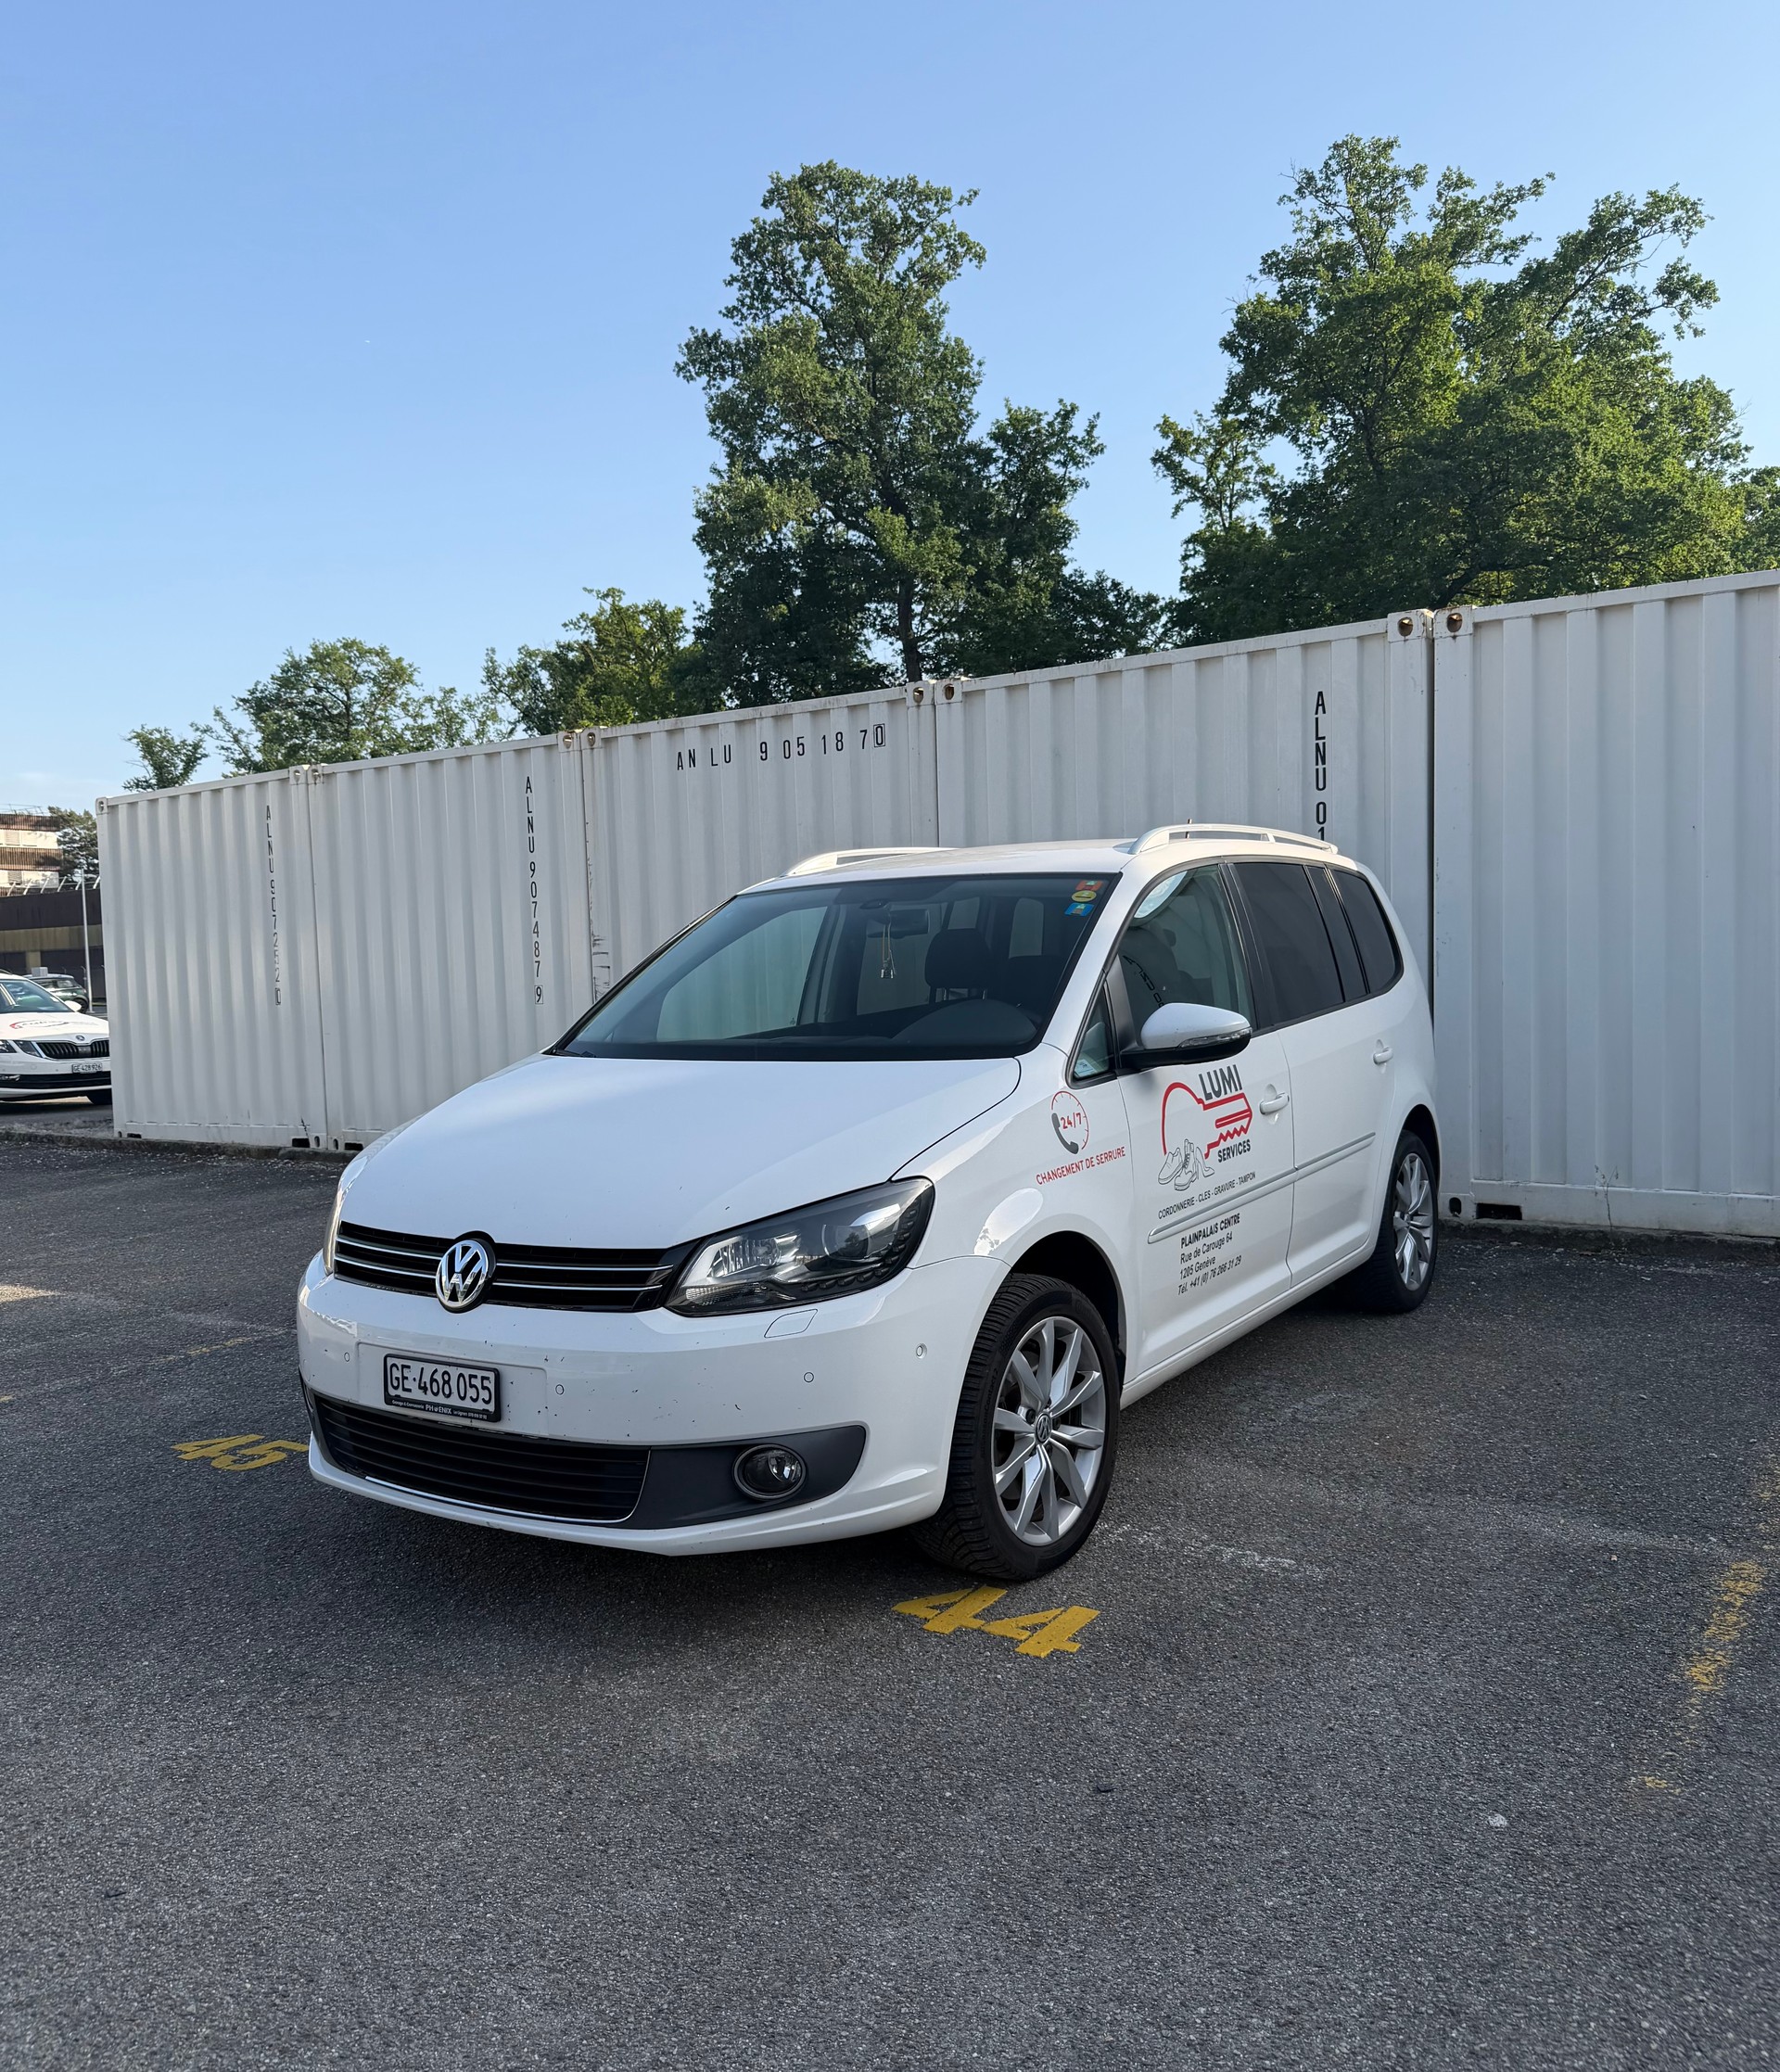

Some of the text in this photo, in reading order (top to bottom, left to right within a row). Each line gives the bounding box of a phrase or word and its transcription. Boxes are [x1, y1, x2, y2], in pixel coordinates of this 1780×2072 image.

[1314, 691, 1327, 792] ALNU
[526, 776, 535, 854] ALNU
[266, 805, 274, 873] ALNU
[529, 861, 541, 977] 907487
[1198, 1063, 1243, 1101] LUMI
[1060, 1112, 1082, 1130] 24/7
[1036, 1146, 1126, 1186] CHANGEMENT DE SERRURE
[1217, 1139, 1252, 1163] SERVICES
[1158, 1196, 1195, 1220] CORDONNERIE
[1198, 1189, 1211, 1203] CLES
[1214, 1179, 1236, 1196] GRAVURE
[1239, 1171, 1256, 1186] TAMPON
[1180, 1213, 1240, 1249] PLAINPALAIS CENTRE
[1180, 1231, 1233, 1265] Rue de Carouge 64
[1180, 1256, 1215, 1280] 1205 Genève
[1178, 1281, 1188, 1296] Tél.
[171, 1433, 309, 1471] 45
[891, 1584, 1100, 1659] 44
